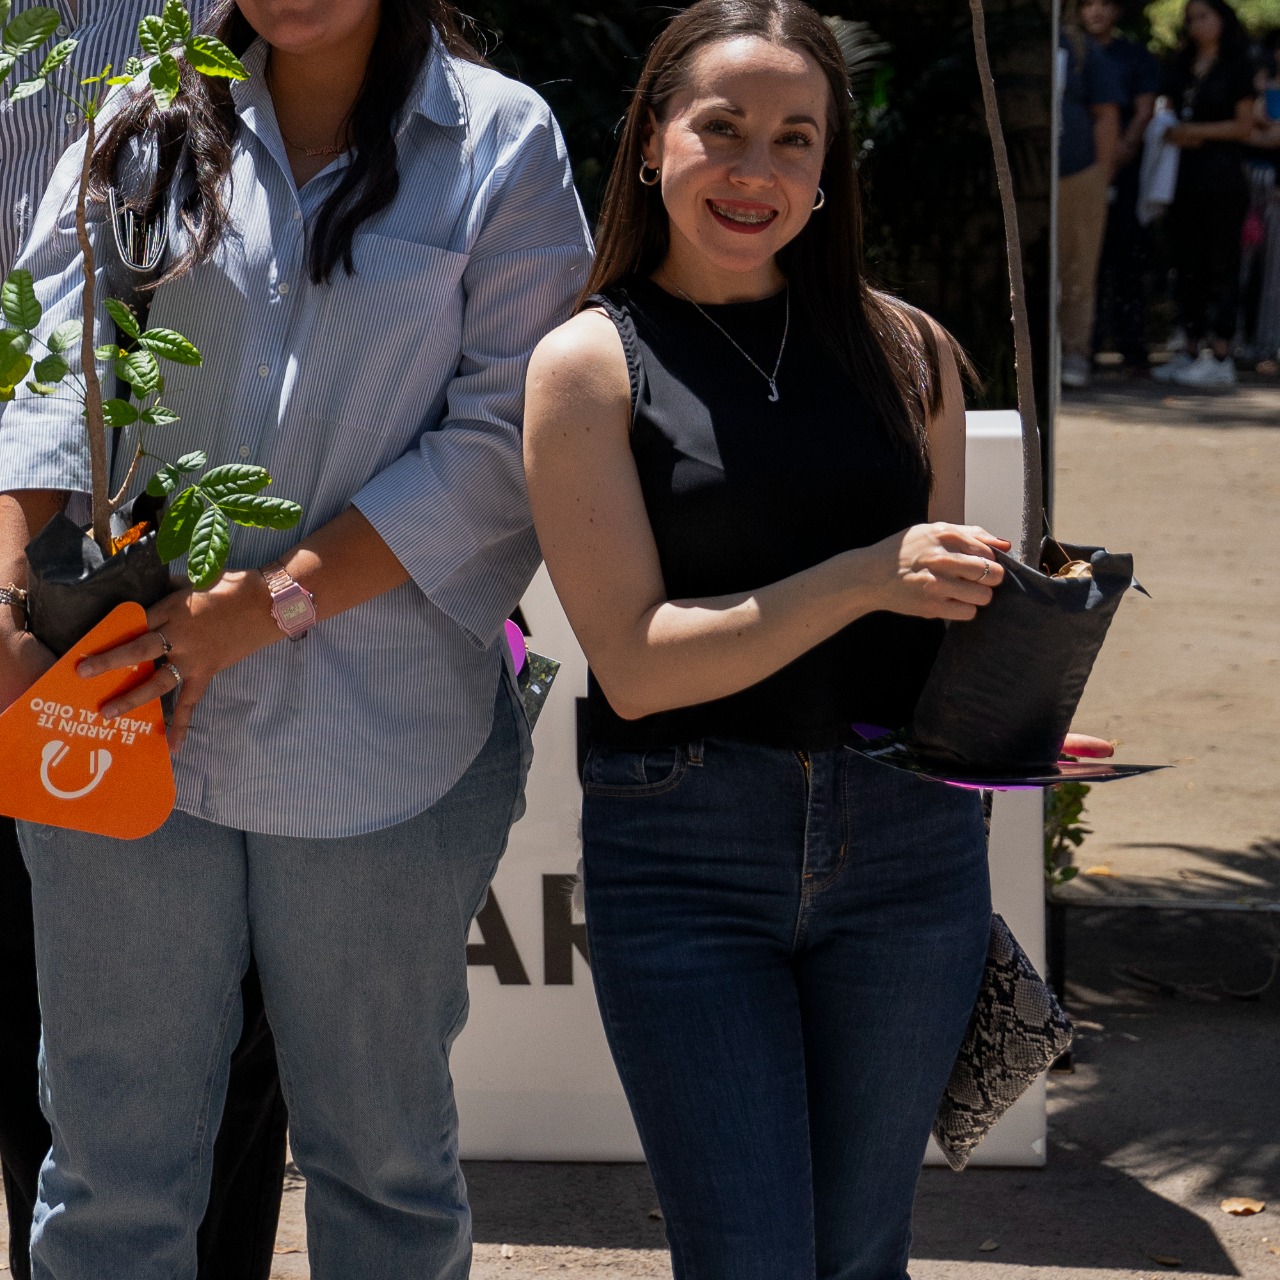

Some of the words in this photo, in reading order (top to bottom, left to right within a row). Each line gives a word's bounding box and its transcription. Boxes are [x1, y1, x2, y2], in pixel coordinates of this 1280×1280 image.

[30, 698, 74, 718] OÍDO
[78, 708, 99, 723] AL
[37, 713, 55, 728] TE
[58, 718, 117, 740] JARDÍN
[121, 731, 136, 745] EL
